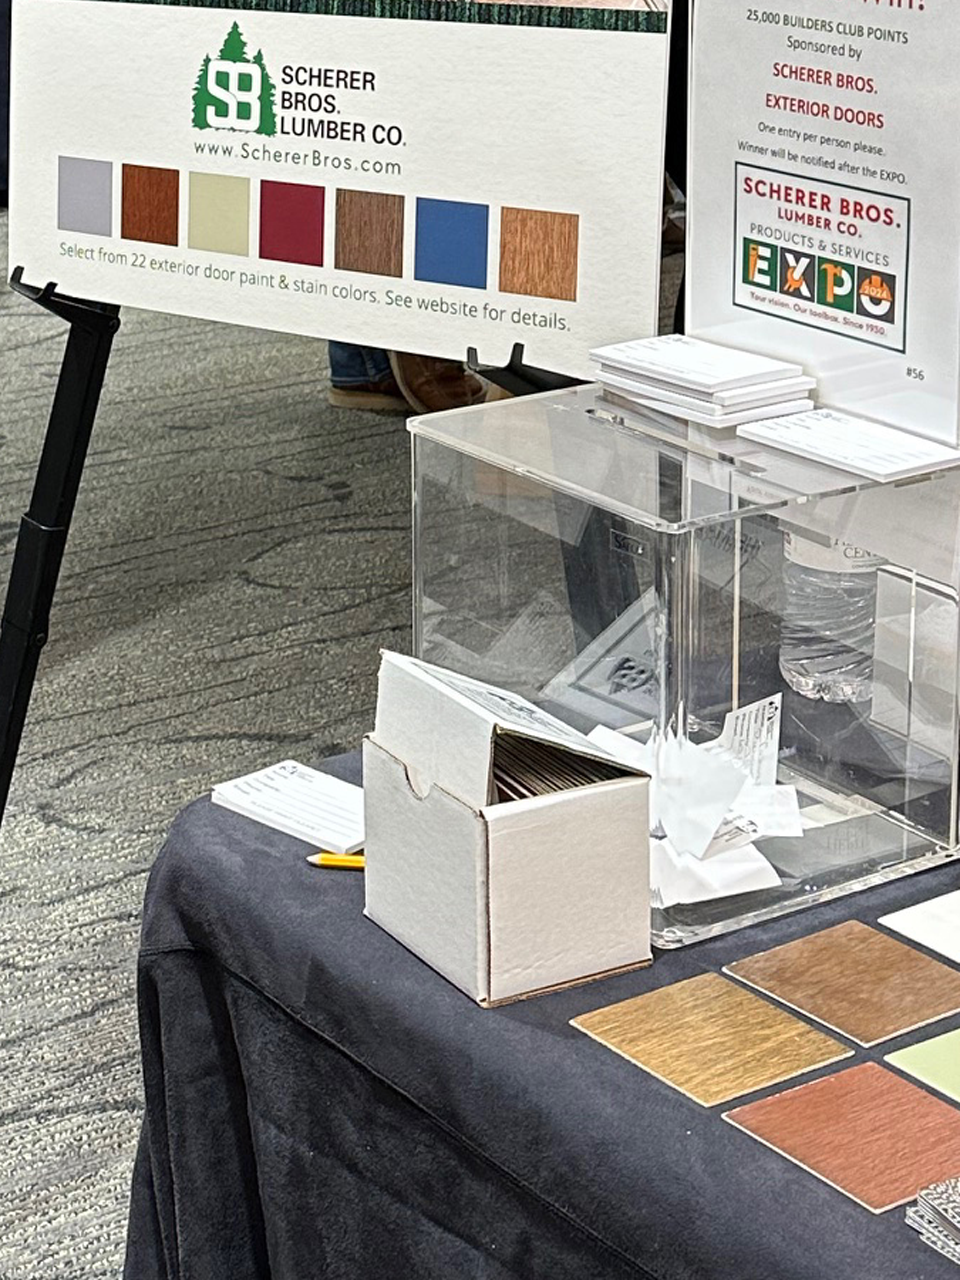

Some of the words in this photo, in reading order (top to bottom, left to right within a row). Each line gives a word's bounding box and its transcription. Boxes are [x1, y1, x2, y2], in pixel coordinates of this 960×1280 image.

[746, 9, 780, 25] 25,000
[783, 14, 834, 33] BUILDERS
[836, 22, 864, 37] CLUB
[867, 26, 908, 44] POINTS
[787, 35, 845, 56] Sponsored
[848, 44, 862, 62] by
[281, 65, 376, 91] SCHERER
[772, 62, 832, 86] SCHERER
[836, 73, 878, 94] BROS.
[206, 59, 262, 132] SB
[281, 91, 341, 114] BROS.
[766, 93, 829, 119] EXTERIOR
[834, 106, 884, 129] DOORS
[280, 116, 365, 142] LUMBER
[372, 124, 407, 147] CO.
[758, 121, 776, 134] One
[778, 127, 801, 141] entry
[803, 131, 817, 144] per
[820, 135, 851, 150] person
[853, 140, 886, 157] please.
[194, 142, 402, 175] www.SchererBros.com
[737, 140, 769, 155] Winner
[771, 147, 785, 159] will
[787, 150, 799, 162] be
[800, 153, 836, 169] notified
[837, 160, 860, 174] after
[862, 165, 878, 177] the
[880, 169, 908, 185] EXPO.
[743, 177, 831, 212] SCHERER
[840, 198, 901, 228] BROS.
[777, 207, 831, 230] LUMBER
[837, 221, 862, 238] CO.
[750, 222, 814, 248] PRODUCTS
[817, 240, 827, 252] &
[830, 243, 890, 266] SERVICES
[59, 241, 95, 261] Select
[98, 247, 128, 266] from
[130, 252, 147, 269] 22
[150, 256, 200, 277] exterior
[203, 262, 236, 282] door
[239, 270, 275, 288] paint
[278, 275, 290, 290] &
[293, 278, 328, 296] stain
[332, 283, 381, 305] colors.
[385, 289, 413, 308] See
[417, 296, 478, 319] website
[482, 302, 507, 321] for
[511, 307, 572, 332] details.
[748, 243, 892, 316] EXPO
[863, 284, 888, 299] 2024
[793, 303, 808, 315] Our
[809, 308, 841, 324] toolbox.
[842, 316, 864, 330] Since
[906, 366, 925, 381] #56
